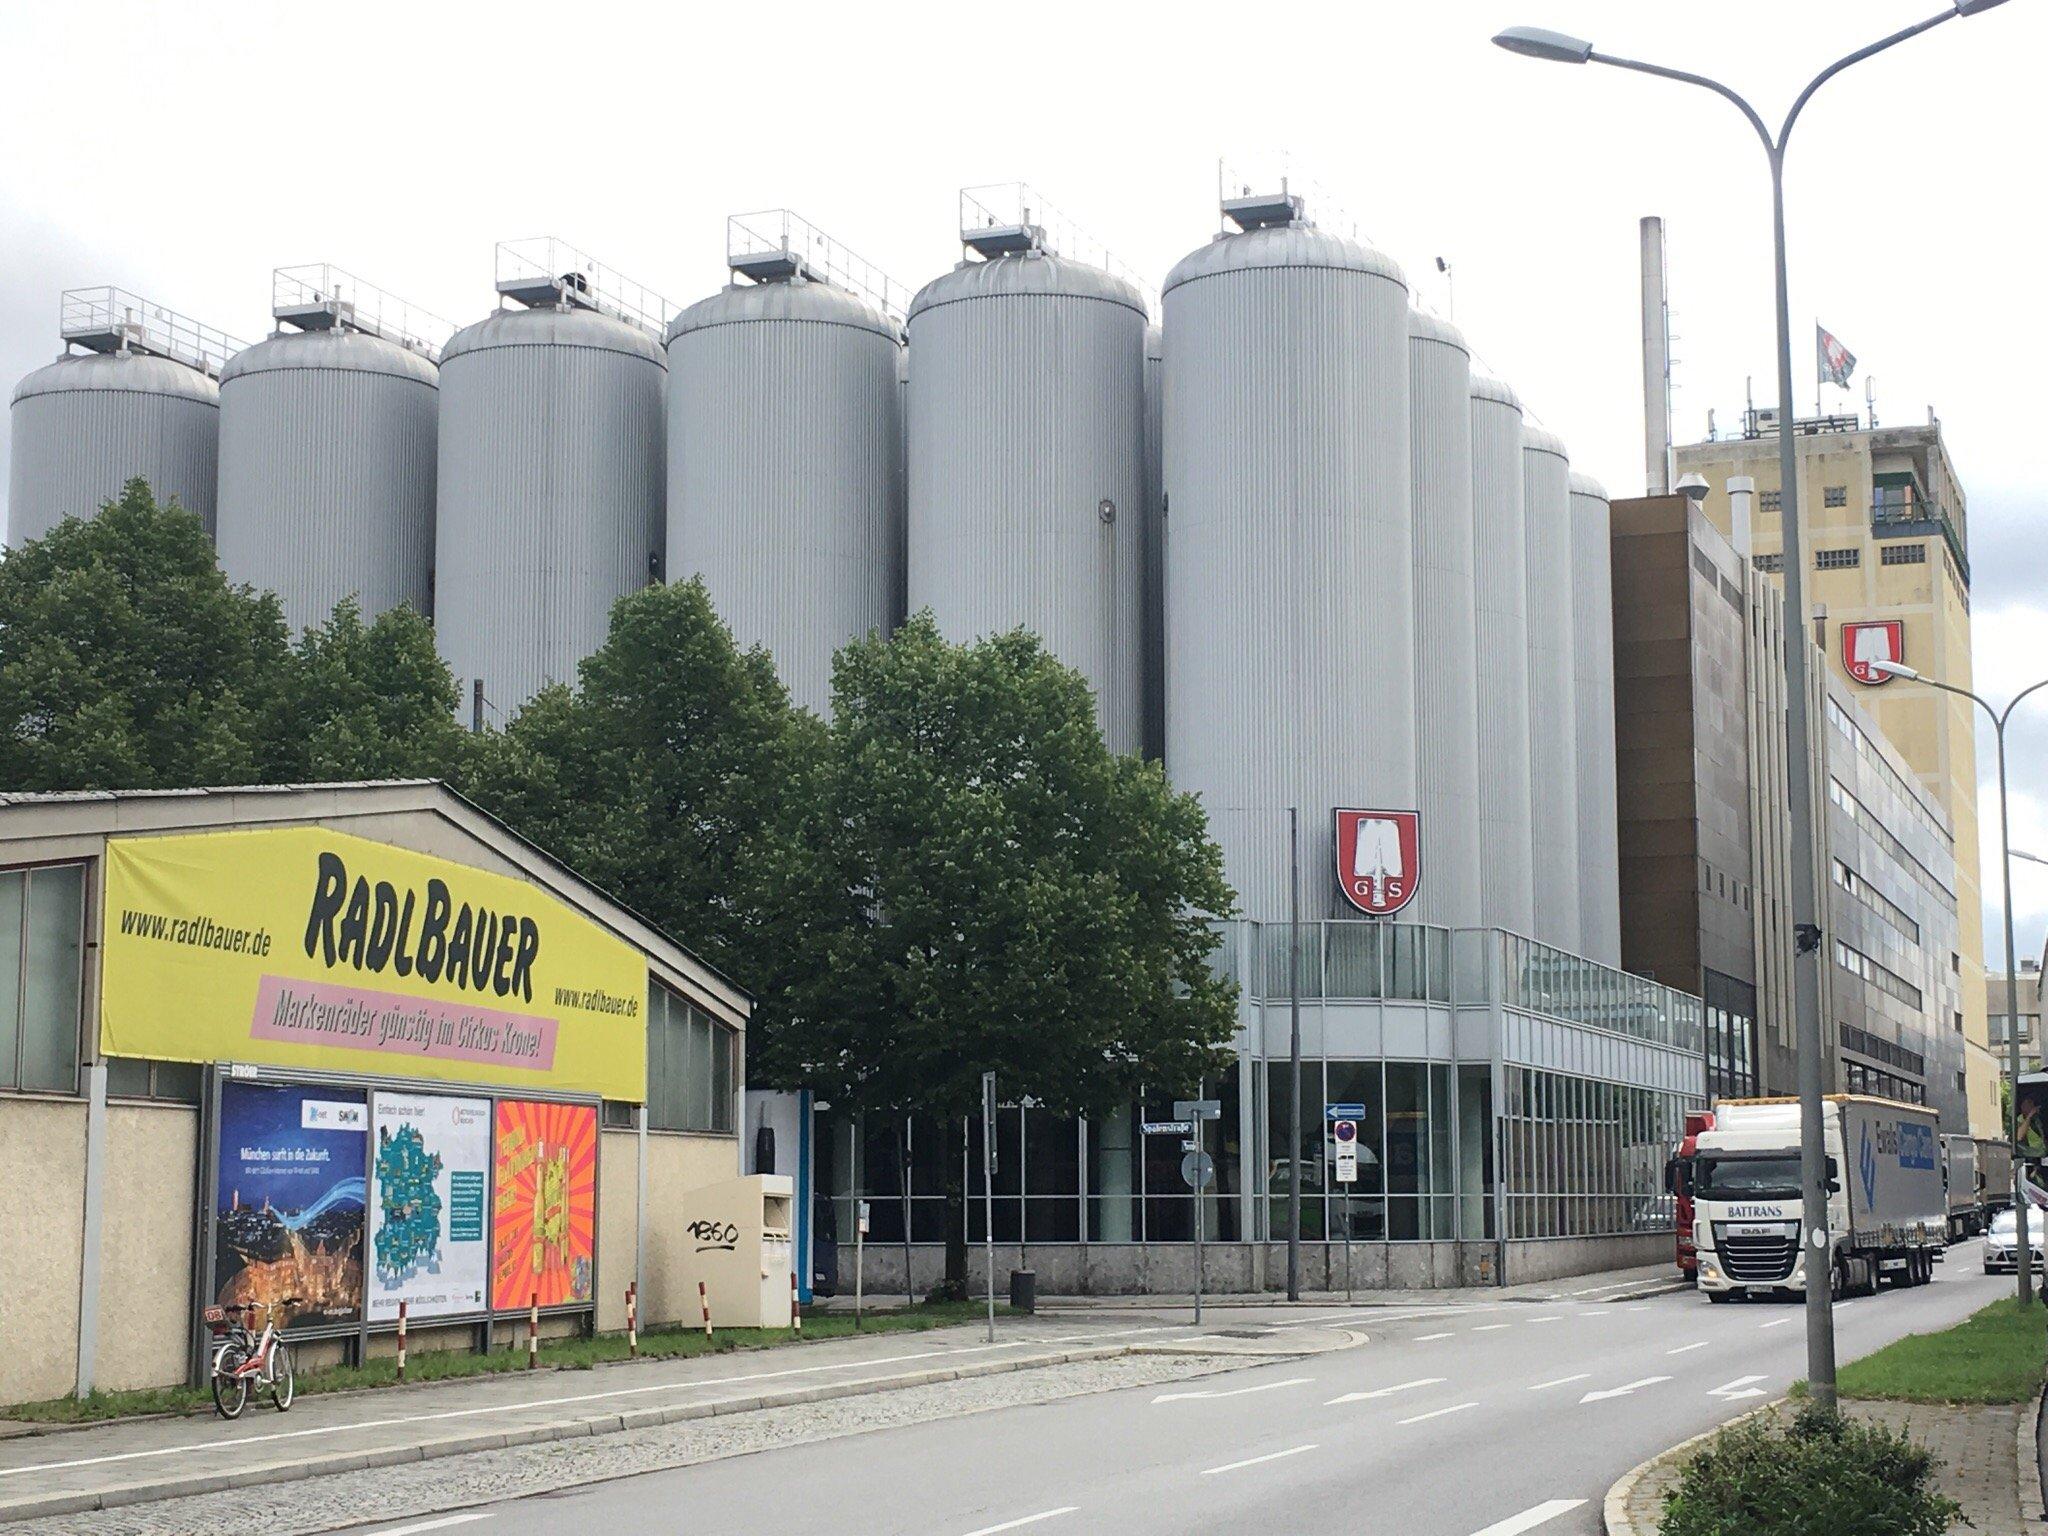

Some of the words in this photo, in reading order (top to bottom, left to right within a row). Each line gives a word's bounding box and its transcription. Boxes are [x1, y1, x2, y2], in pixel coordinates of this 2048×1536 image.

[1354, 880, 1369, 895] G
[1388, 882, 1402, 898] S
[121, 909, 271, 957] www.radlbauer.de
[304, 852, 539, 1004] RADLBAUER
[555, 986, 638, 1018] www.radlbauer.de
[272, 989, 378, 1037] Markenräder
[378, 1004, 434, 1051] günstig
[435, 1012, 455, 1046] im
[240, 1147, 271, 1161] München
[1728, 1206, 1782, 1217] BATTRANS
[687, 1220, 739, 1243] 1860
